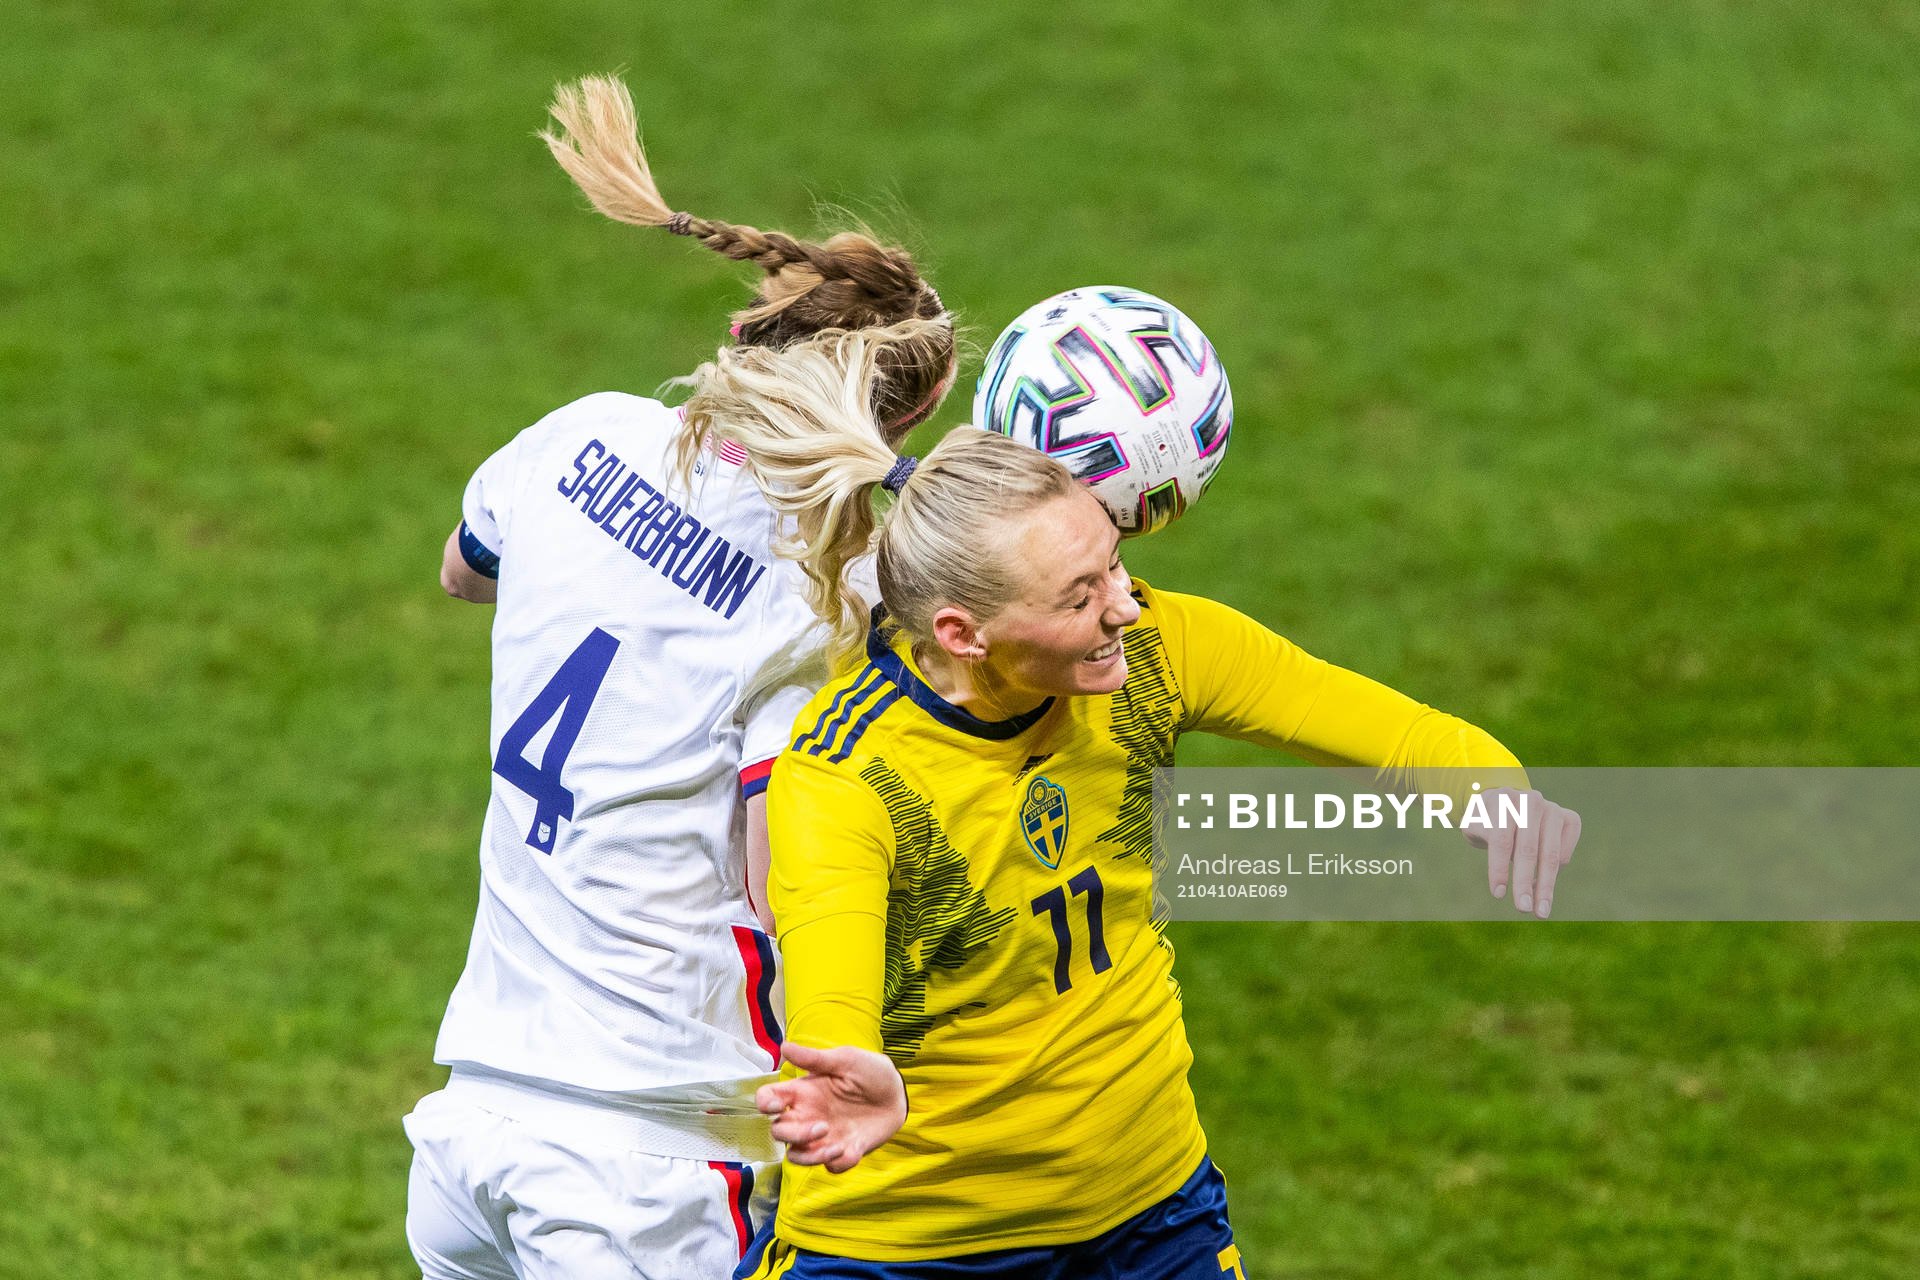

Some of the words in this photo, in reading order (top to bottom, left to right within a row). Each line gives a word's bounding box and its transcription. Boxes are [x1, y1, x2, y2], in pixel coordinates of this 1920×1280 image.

[557, 438, 767, 620] SAUERBRUNN
[492, 626, 621, 856] 4
[1028, 797, 1058, 820] SVERIGE
[1030, 864, 1114, 996] 11
